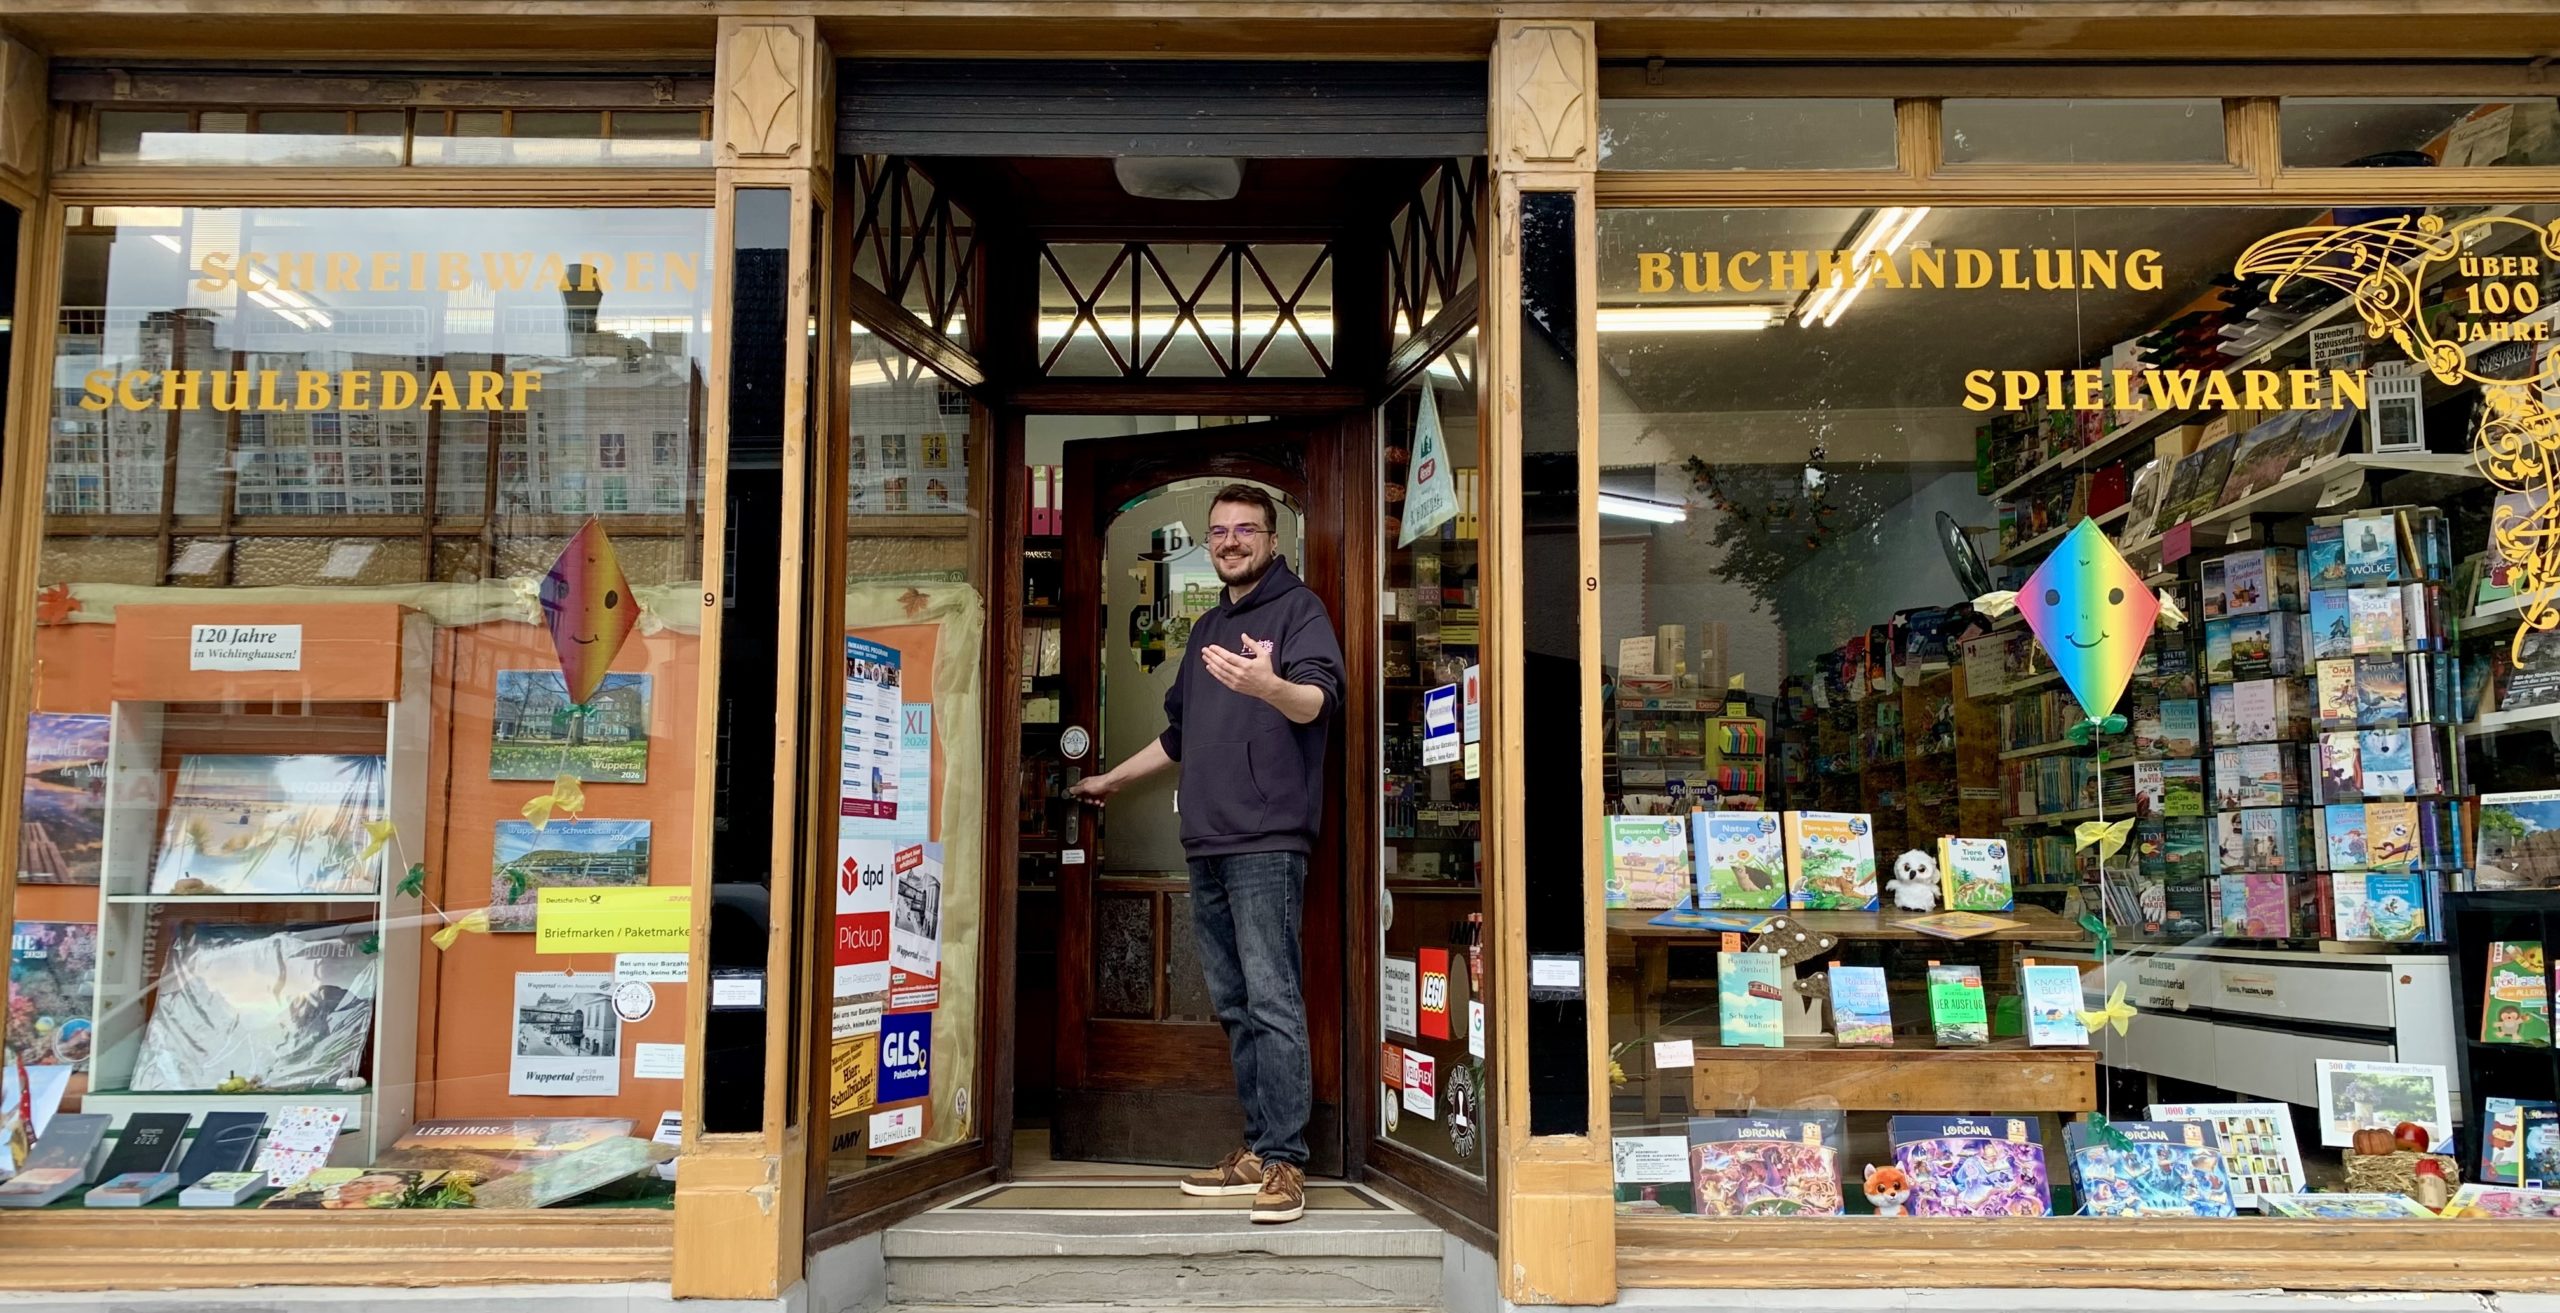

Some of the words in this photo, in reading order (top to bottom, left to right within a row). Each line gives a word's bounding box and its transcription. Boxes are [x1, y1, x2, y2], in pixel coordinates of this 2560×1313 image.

[1637, 248, 2163, 293] BUCHHANDLUNG
[2458, 251, 2540, 277] ÜBER
[197, 250, 700, 292] SCHREIBWAREN
[2465, 281, 2539, 314] 100
[2313, 326, 2354, 341] Harenberg
[2457, 321, 2550, 342] JAHRE
[2315, 351, 2327, 360] 20.
[79, 369, 543, 412] SCHULBEDARF
[1962, 368, 2367, 412] SPIELWAREN
[1025, 550, 1052, 559] PARKER
[2351, 563, 2392, 575] WOLKE
[1586, 576, 1598, 592] 9
[703, 592, 715, 607] 9
[195, 627, 226, 645] 120
[230, 627, 277, 648] Jahre
[193, 648, 205, 659] in
[208, 647, 297, 664] Wichlinghausen!
[2332, 666, 2353, 675] OMA
[904, 710, 928, 735] XL
[904, 737, 928, 747] 2026
[60, 758, 79, 778] der
[591, 761, 641, 772] Wuppertal
[2181, 803, 2199, 811] TOD
[2247, 811, 2273, 820] HERA
[1619, 827, 1661, 836] Bauernhof
[1721, 824, 1751, 833] Natur
[2245, 819, 2278, 831] LIND
[609, 834, 628, 842] 2026
[1962, 848, 1983, 857] Tiere
[862, 863, 884, 892] dpd
[544, 928, 615, 939] Briefmarken
[616, 927, 622, 937] /
[839, 925, 883, 952] Pickup
[896, 944, 919, 961] Wuppertal
[1740, 966, 1769, 974] Ortheil
[2148, 958, 2176, 971] Diverses
[619, 969, 649, 977] möglich,
[1384, 966, 1411, 982] Fotokopien
[2138, 974, 2185, 991] Bastelmaterial
[1421, 972, 1448, 1013] LEGO
[1935, 999, 1950, 1010] DER
[1950, 999, 1984, 1010] AUSFLUG
[2149, 993, 2175, 1007] vorrätig
[833, 1011, 841, 1020] Bei
[1728, 1012, 1763, 1020] Schwebe
[832, 1022, 852, 1033] möglich,
[852, 1020, 865, 1029] keine
[865, 1018, 877, 1027] Karte
[1747, 1021, 1778, 1030] bahnen
[882, 1030, 921, 1068] GLS
[2328, 1062, 2344, 1071] 500
[526, 1071, 575, 1083] Wuppertal
[575, 1073, 605, 1083] gestern
[842, 1063, 861, 1084] Hier:
[893, 1068, 918, 1080] PaketShop
[831, 1068, 874, 1110] Schulbücher!
[2164, 1106, 2184, 1115] 1000
[2207, 1106, 2254, 1117] Ravensburger
[2253, 1106, 2275, 1115] Puzzle
[415, 1125, 500, 1137] LIEBLINGS
[874, 1126, 917, 1145] BUCHHÜLLEN
[1738, 1128, 1787, 1139] LORCANA
[1942, 1124, 1992, 1137] LORCANA
[133, 1136, 160, 1145] 2026
[831, 1129, 862, 1151] LAMY
